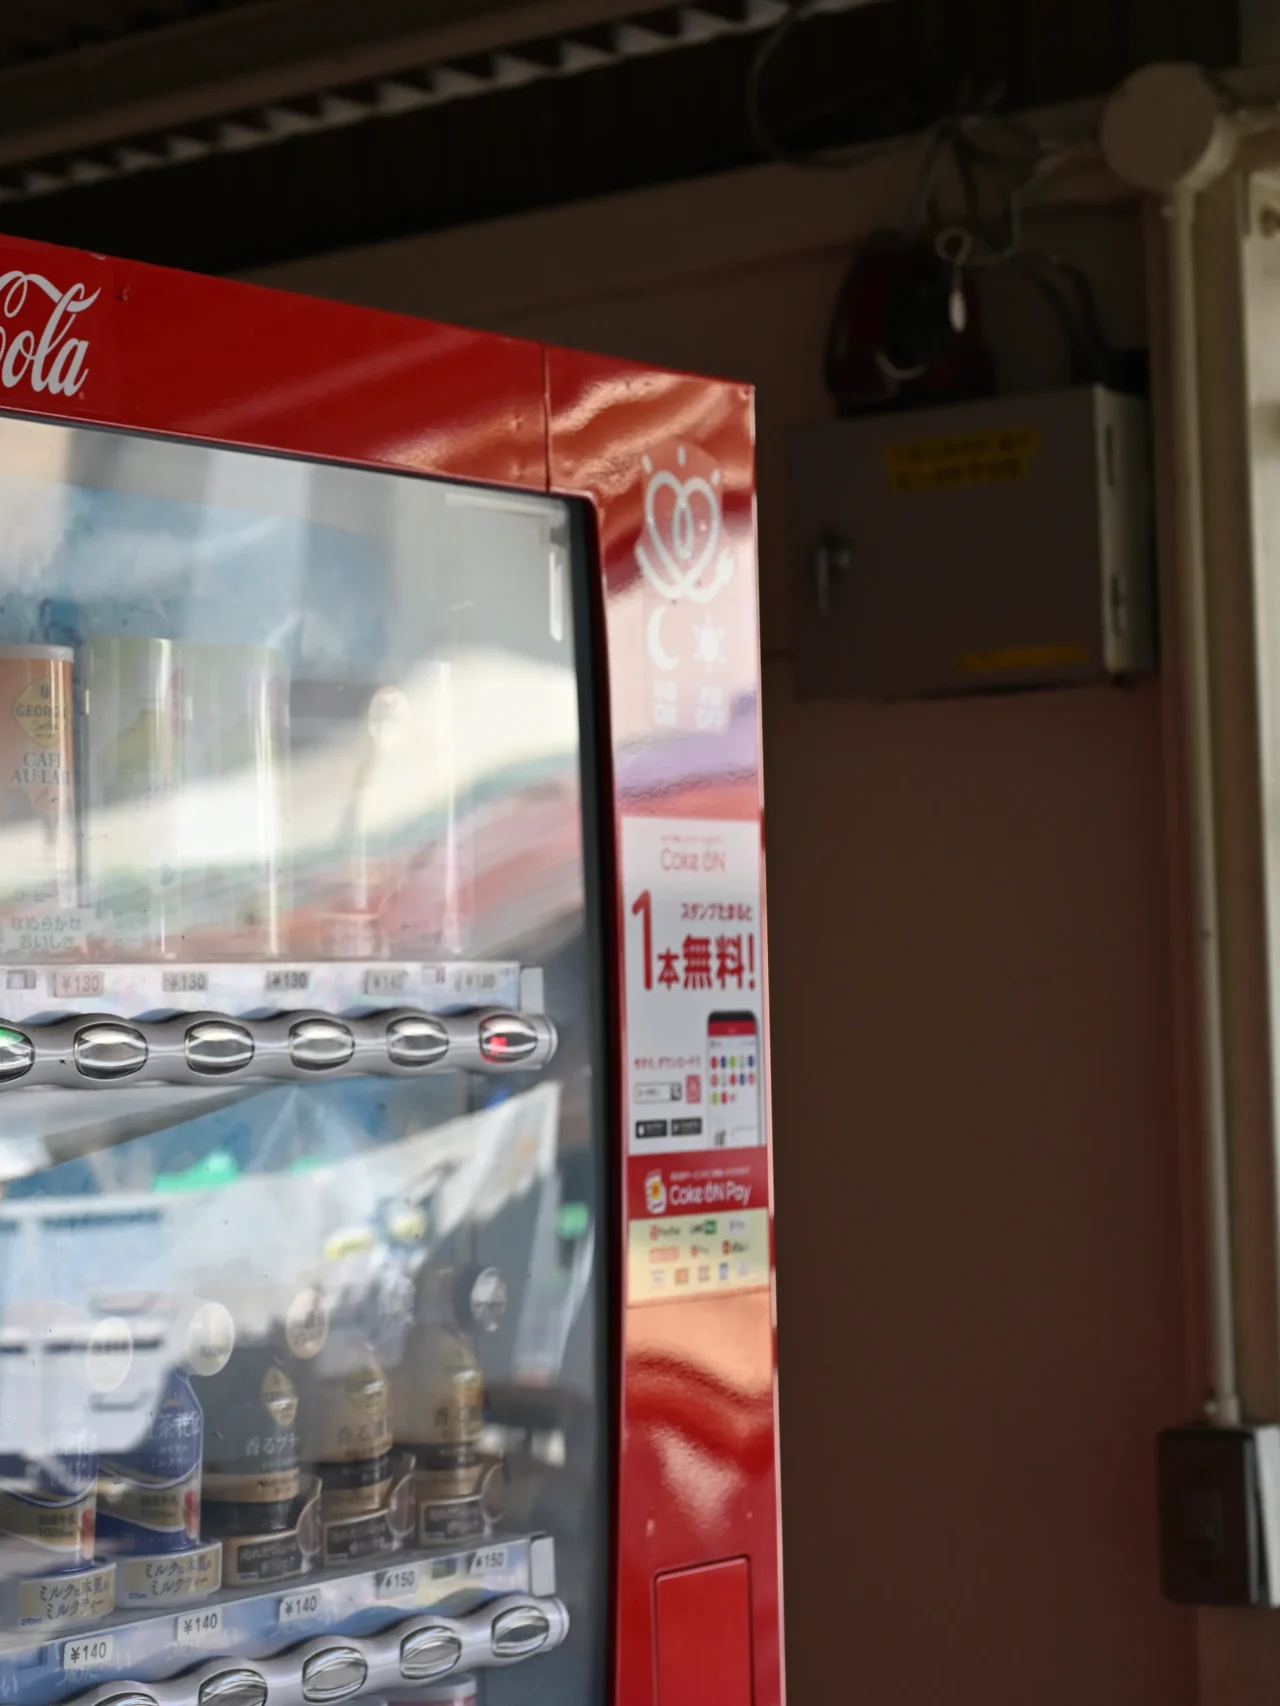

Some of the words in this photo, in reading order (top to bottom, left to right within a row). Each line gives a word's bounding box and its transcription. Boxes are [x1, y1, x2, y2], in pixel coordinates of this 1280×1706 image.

[661, 848, 700, 872] Coke
[703, 849, 726, 873] ON
[61, 974, 100, 993] ¥130
[169, 971, 206, 991] ¥130
[670, 1185, 703, 1206] Coke
[705, 1181, 725, 1203] ON
[726, 1180, 752, 1206] Pay
[45, 1599, 105, 1621] ミルクティー
[284, 1596, 318, 1615] ¥140
[183, 1612, 219, 1636] ¥140
[70, 1642, 108, 1664] ¥140
